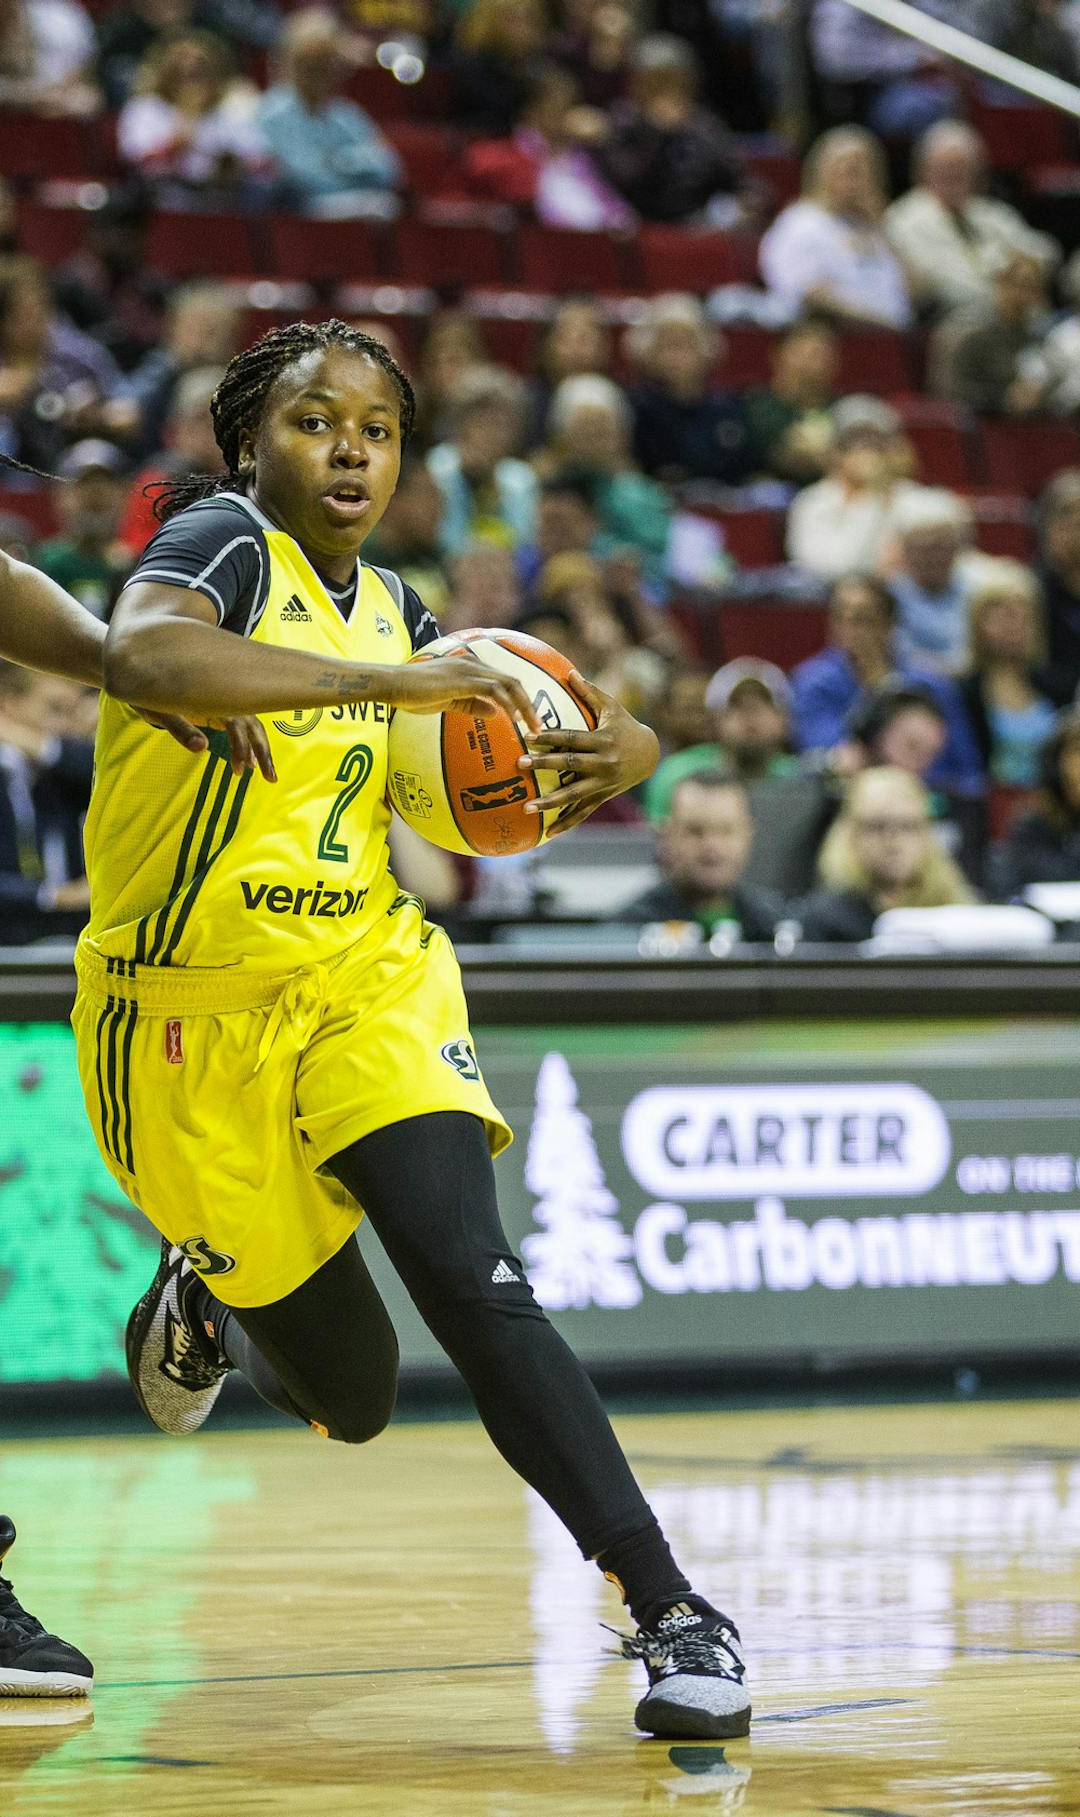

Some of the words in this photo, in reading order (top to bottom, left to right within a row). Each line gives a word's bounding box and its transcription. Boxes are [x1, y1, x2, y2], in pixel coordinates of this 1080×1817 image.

[280, 611, 312, 622] adidas
[317, 744, 374, 863] 2
[663, 1115, 906, 1168] CARTER
[658, 1614, 702, 1629] adidas
